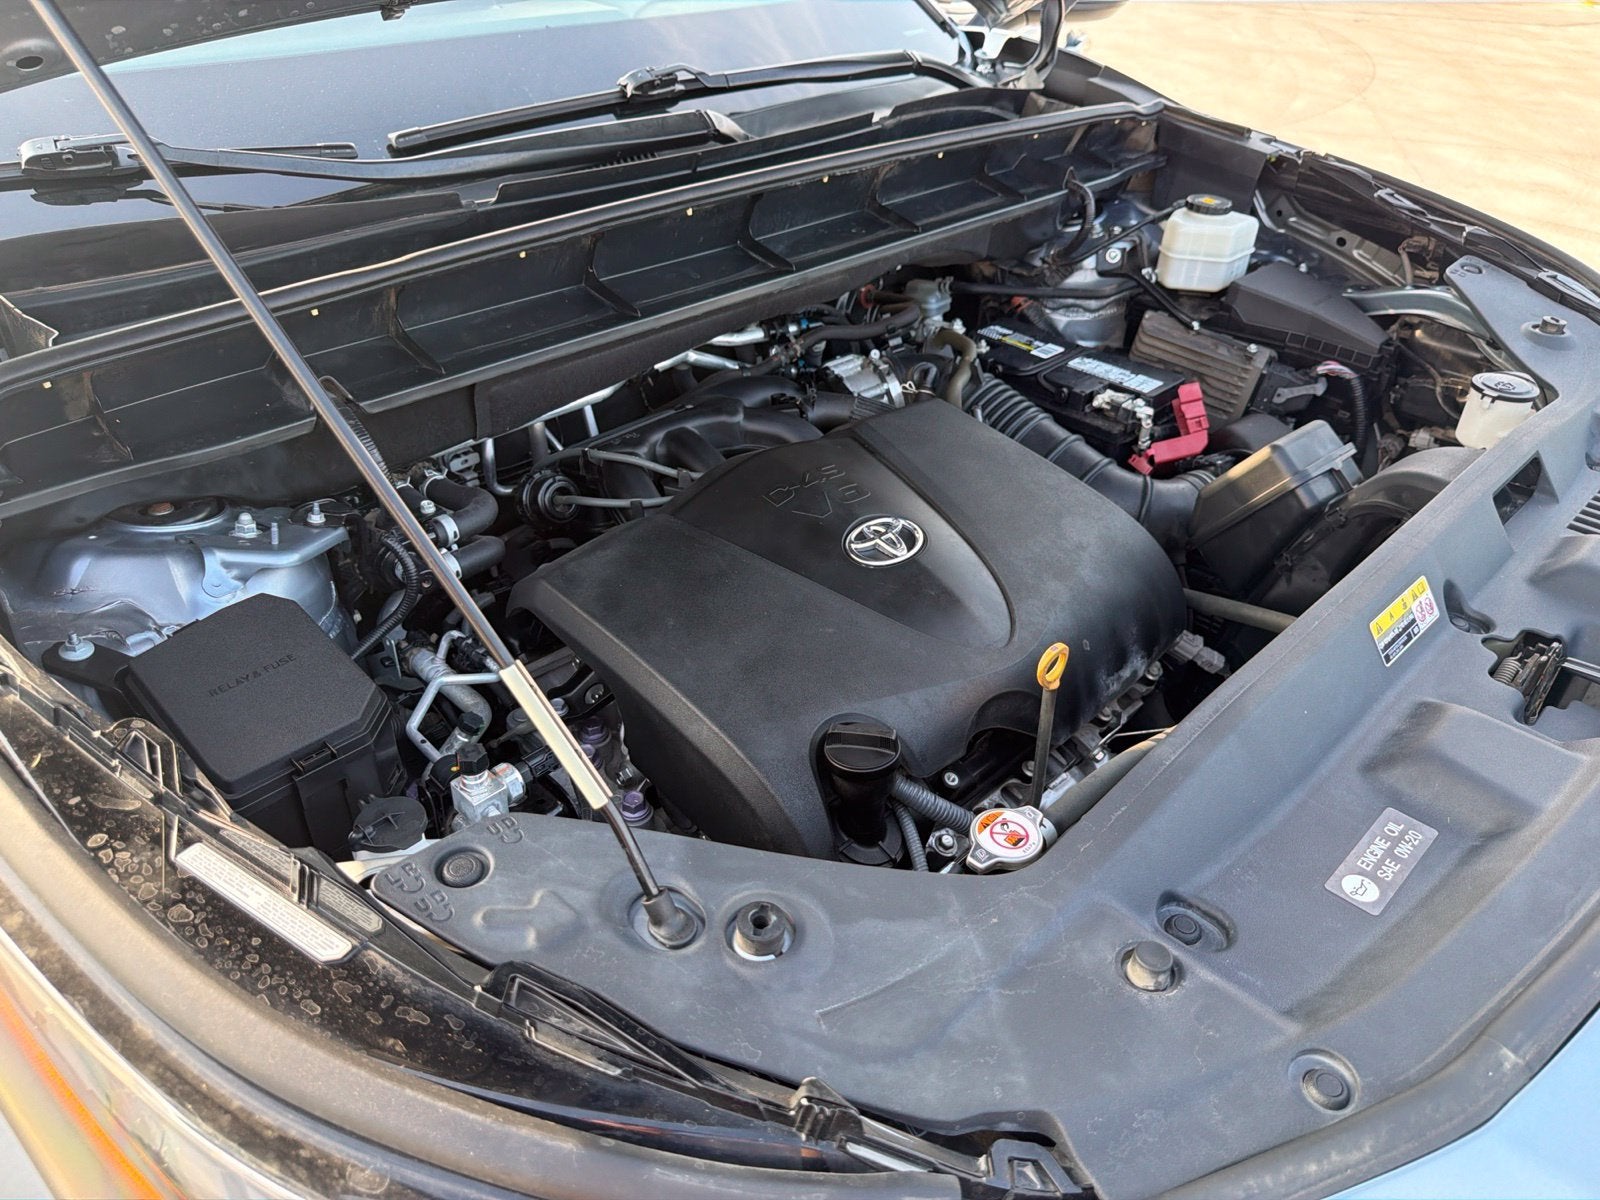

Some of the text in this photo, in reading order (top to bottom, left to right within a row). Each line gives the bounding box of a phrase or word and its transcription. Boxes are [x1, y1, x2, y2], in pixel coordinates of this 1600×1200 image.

[208, 674, 250, 697] RELAY
[263, 653, 297, 673] FUSE
[1356, 821, 1405, 871] ENGINE OIL
[1376, 829, 1423, 881] SAE 0W-20
